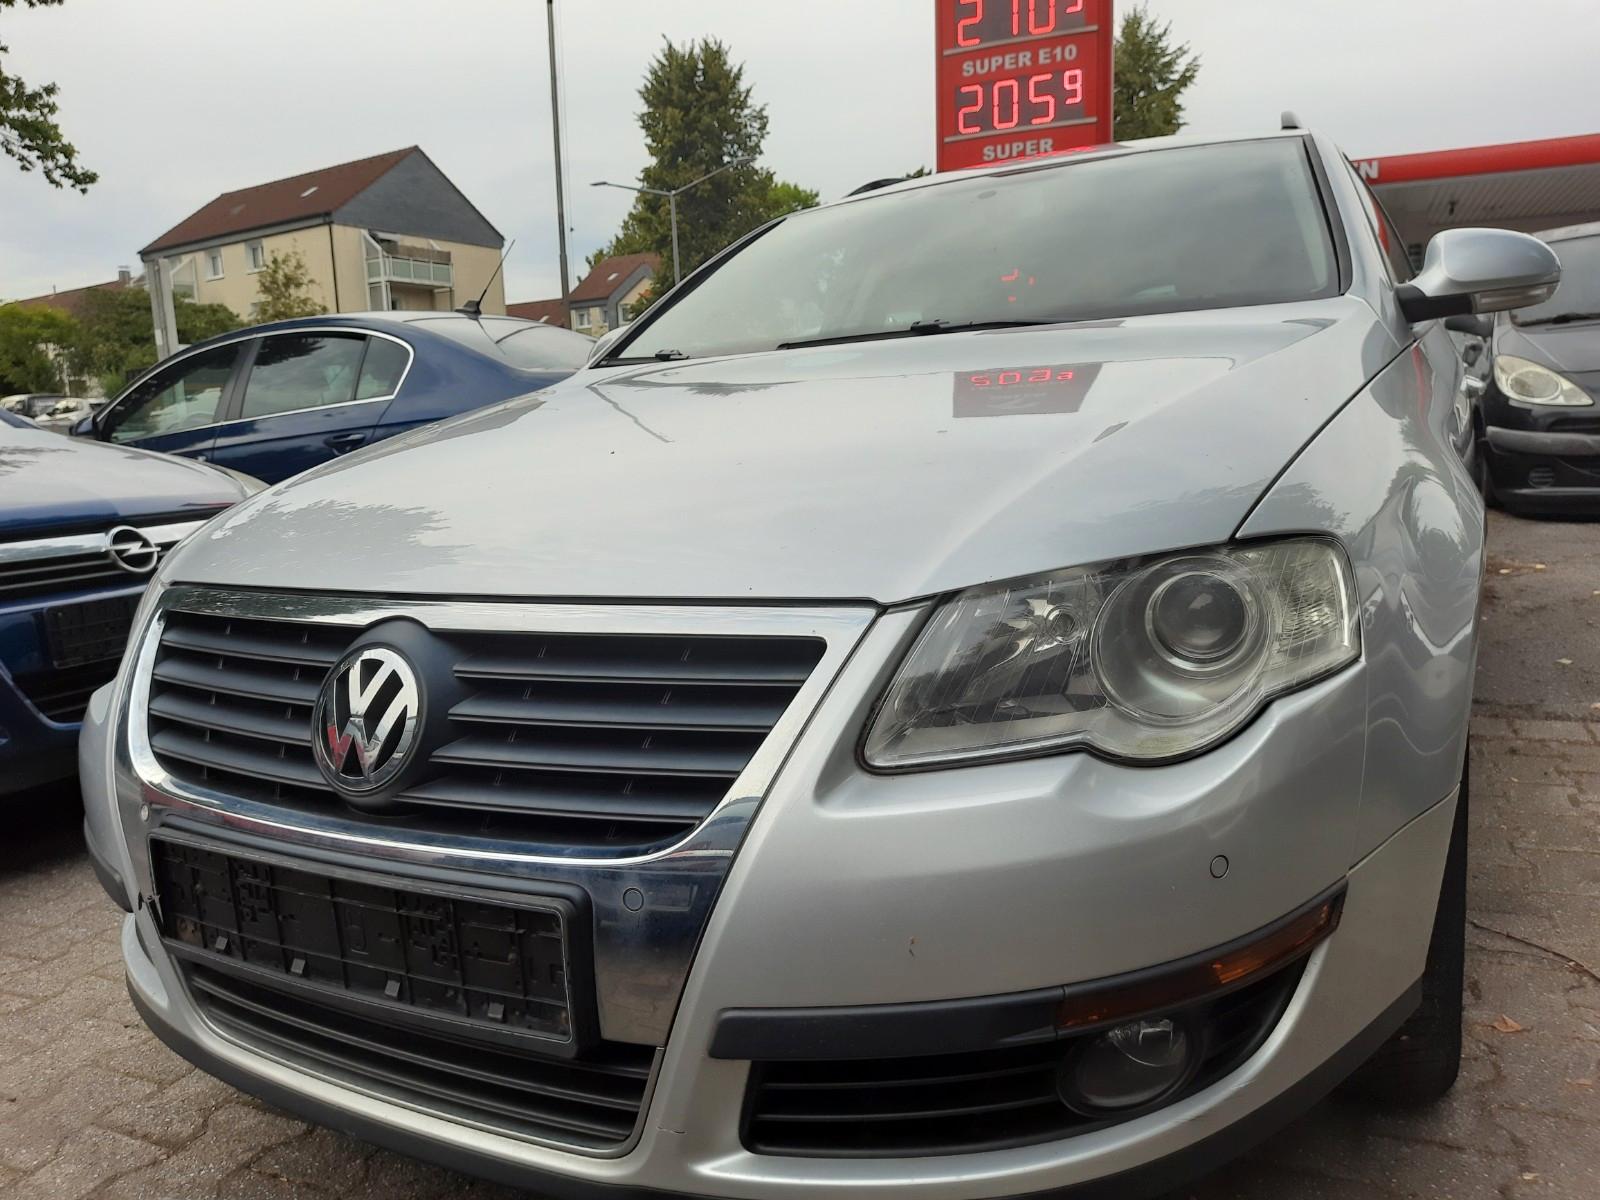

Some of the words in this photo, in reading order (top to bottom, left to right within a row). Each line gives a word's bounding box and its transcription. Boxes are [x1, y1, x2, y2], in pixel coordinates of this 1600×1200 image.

[962, 50, 1032, 77] SUPER
[1038, 43, 1078, 65] E10
[958, 68, 1083, 134] 2059
[982, 137, 1054, 162] SUPER
[1352, 159, 1379, 179] N
